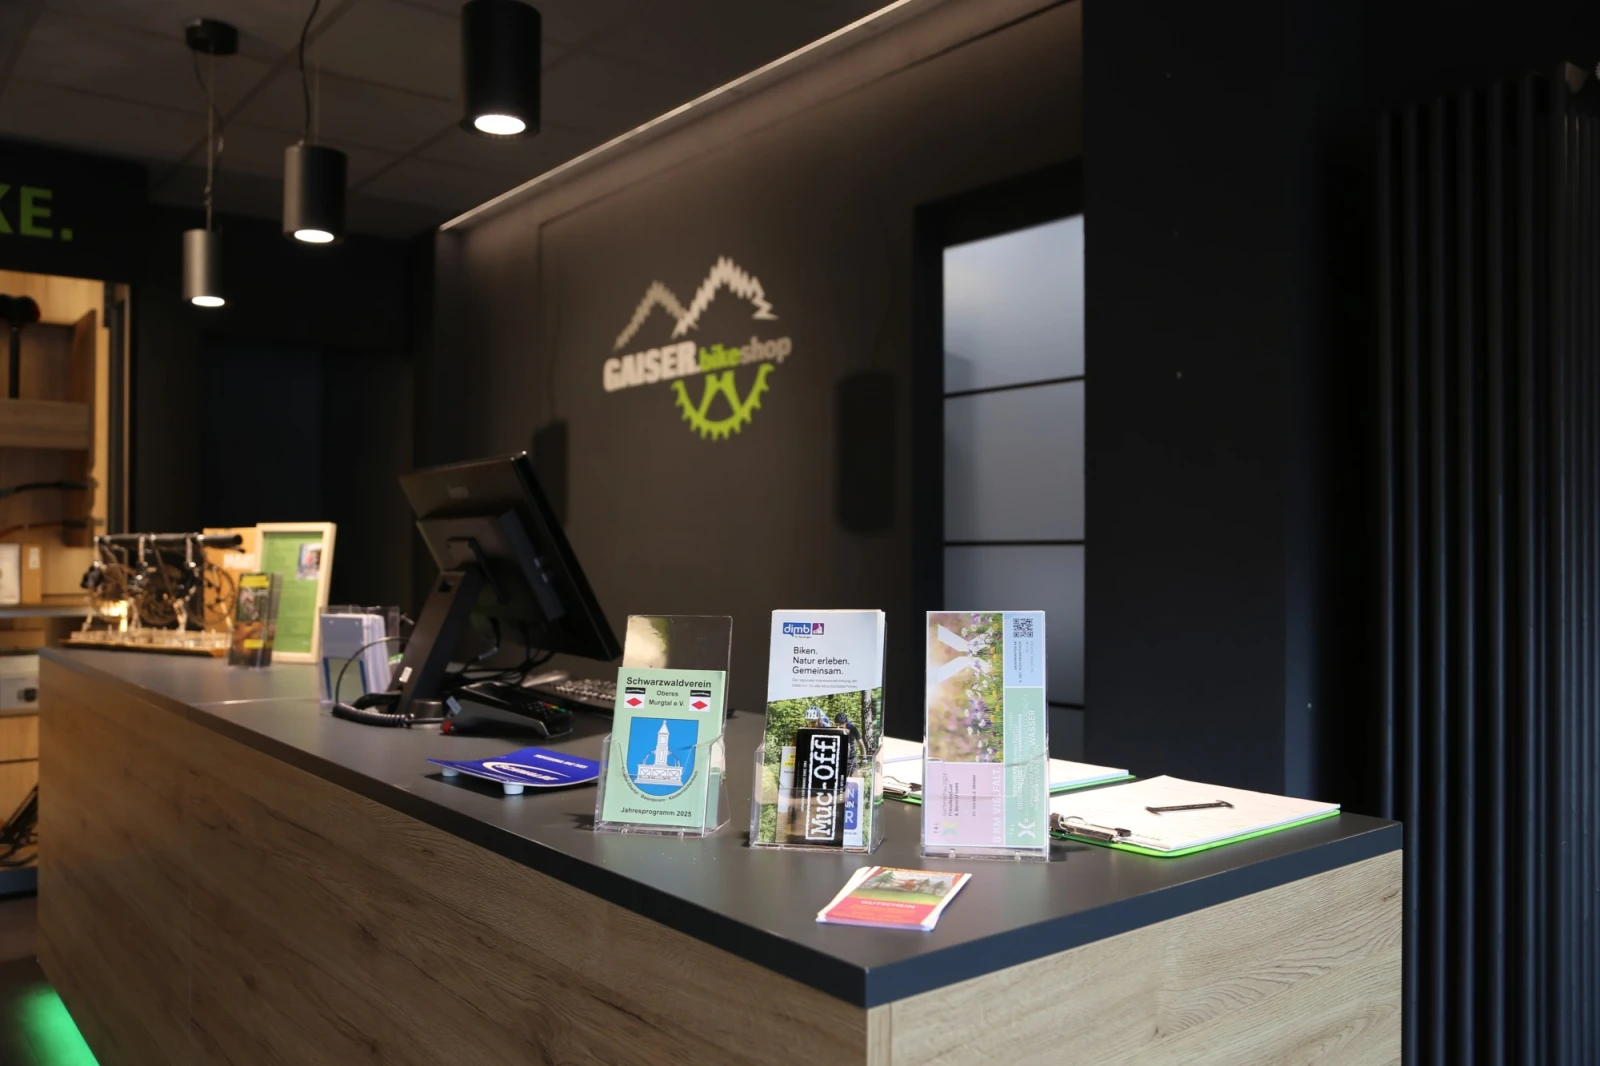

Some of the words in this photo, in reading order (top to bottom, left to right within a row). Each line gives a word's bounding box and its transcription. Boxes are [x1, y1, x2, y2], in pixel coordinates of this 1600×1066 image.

[783, 624, 810, 636] dimb
[793, 646, 818, 655] Biken.
[792, 656, 815, 665] Natur
[817, 656, 850, 665] erleben.
[792, 666, 844, 675] Gemeinsam.
[626, 677, 712, 688] Schwarzwaldverein
[649, 699, 672, 708] Murgtal
[1028, 710, 1036, 745] WASSER
[811, 739, 837, 836] Muc-Off
[992, 766, 1001, 814] VIELFALT.
[620, 807, 675, 817] Jahresprogramm
[676, 810, 692, 818] 2025
[992, 817, 1001, 834] KM
